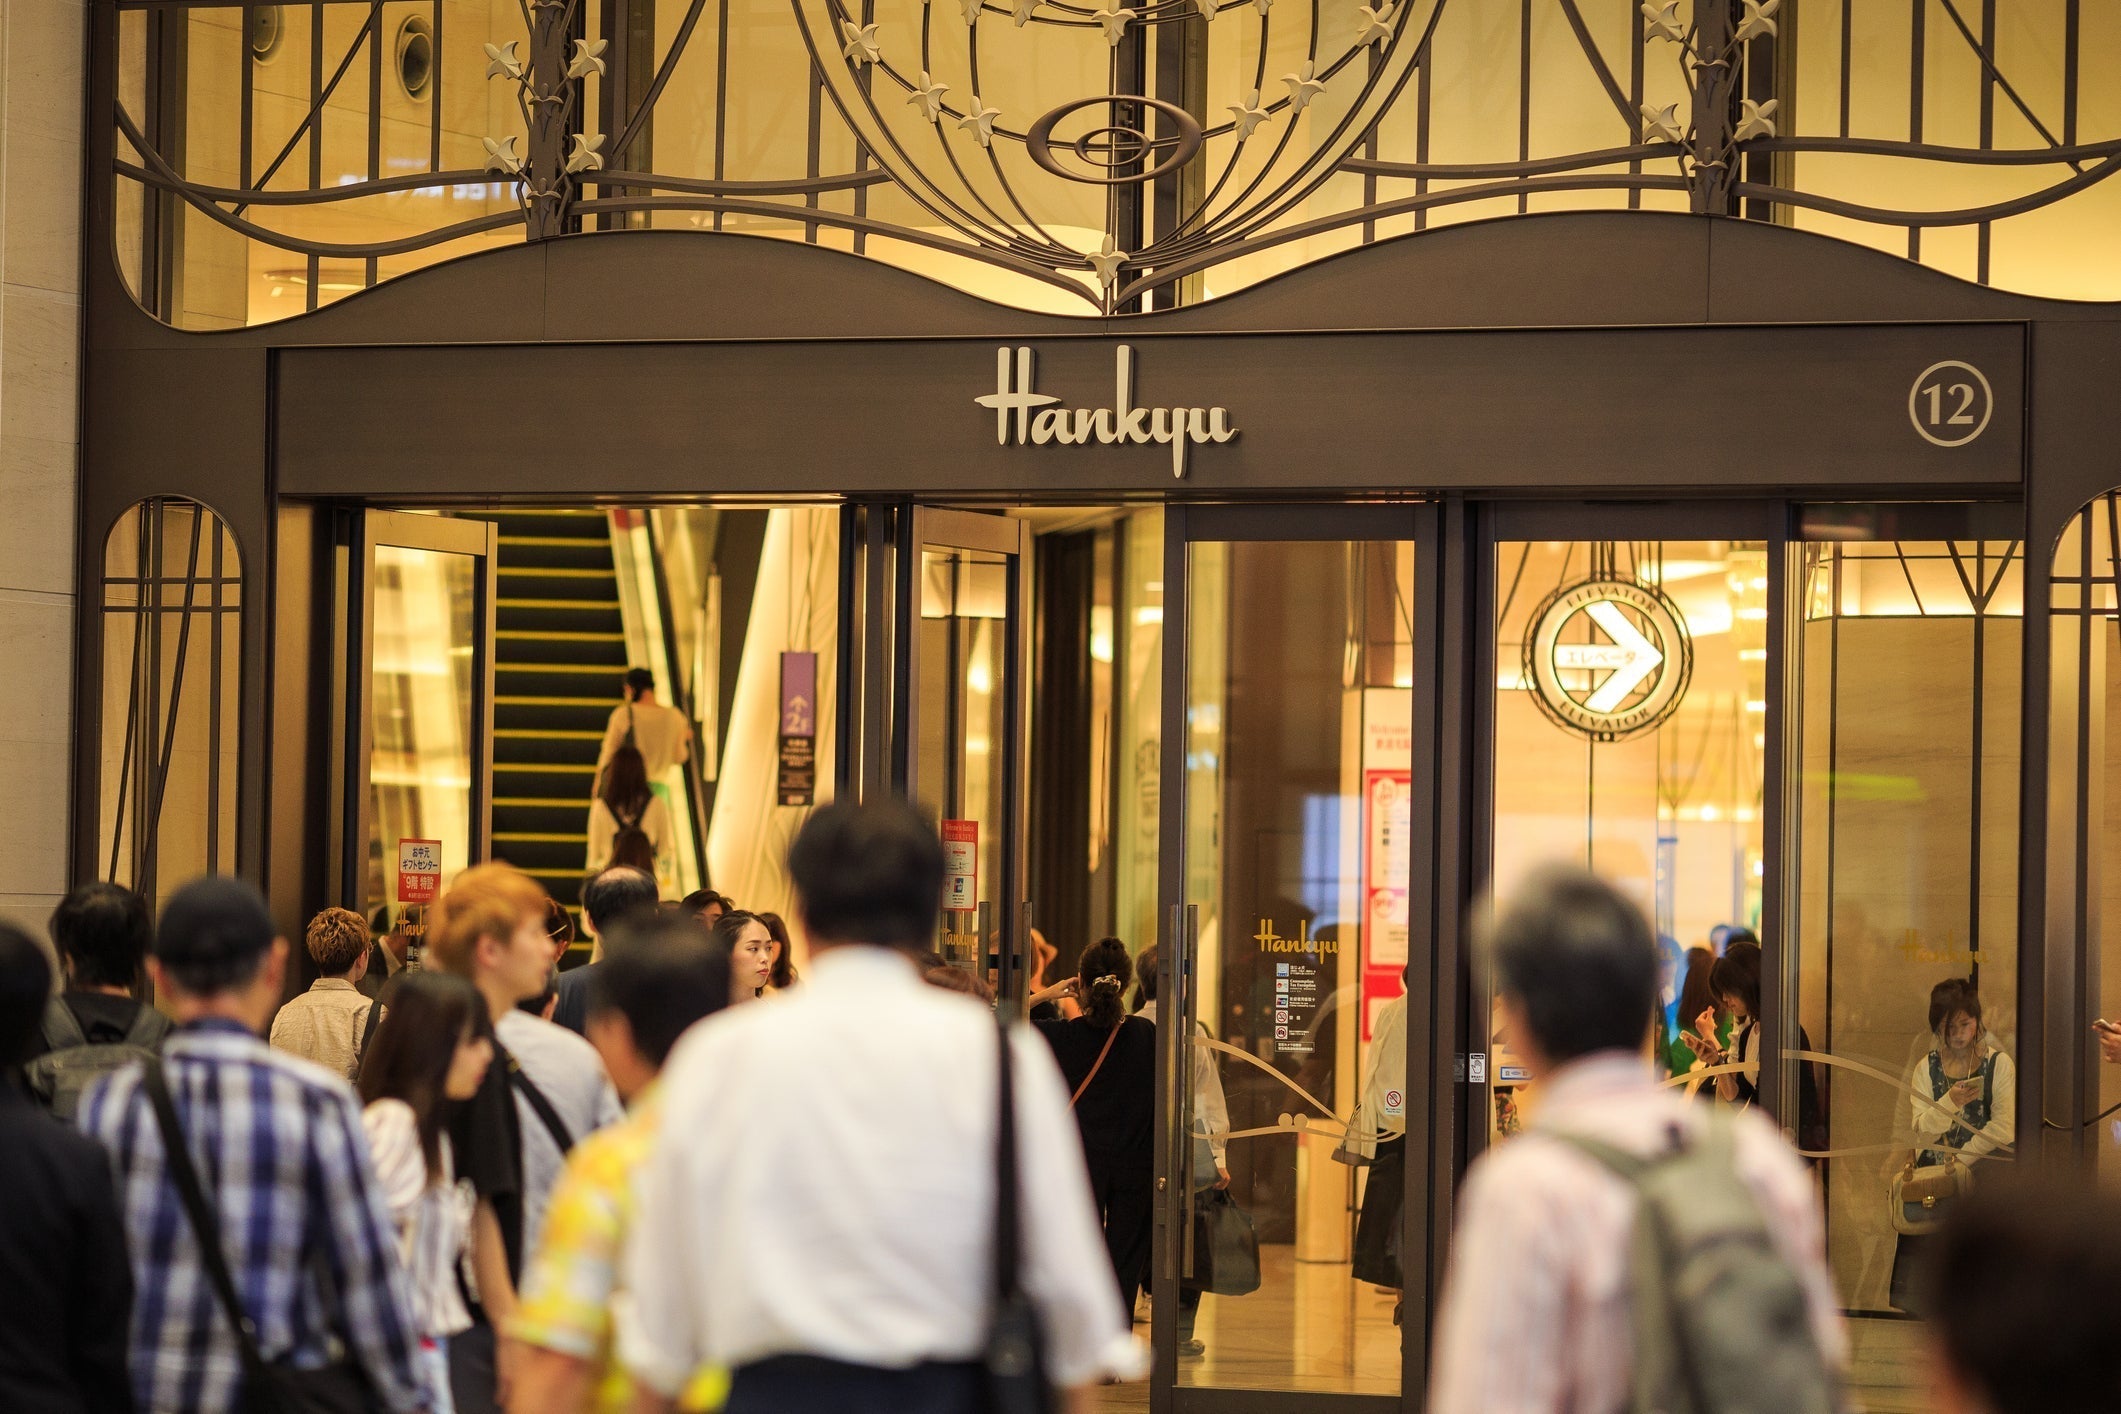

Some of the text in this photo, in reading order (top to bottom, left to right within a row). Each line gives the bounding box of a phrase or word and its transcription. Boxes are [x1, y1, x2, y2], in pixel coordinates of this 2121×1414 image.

[974, 344, 1240, 480] Hankyu
[1921, 382, 1974, 425] 12
[1566, 584, 1657, 614] ELEVATOR
[1566, 651, 1648, 665] エレベーター
[1559, 700, 1651, 730] ELEVATOR
[402, 859, 438, 871] ギフトセンター
[412, 846, 430, 859] お中元
[1253, 918, 1341, 965] Hankyu
